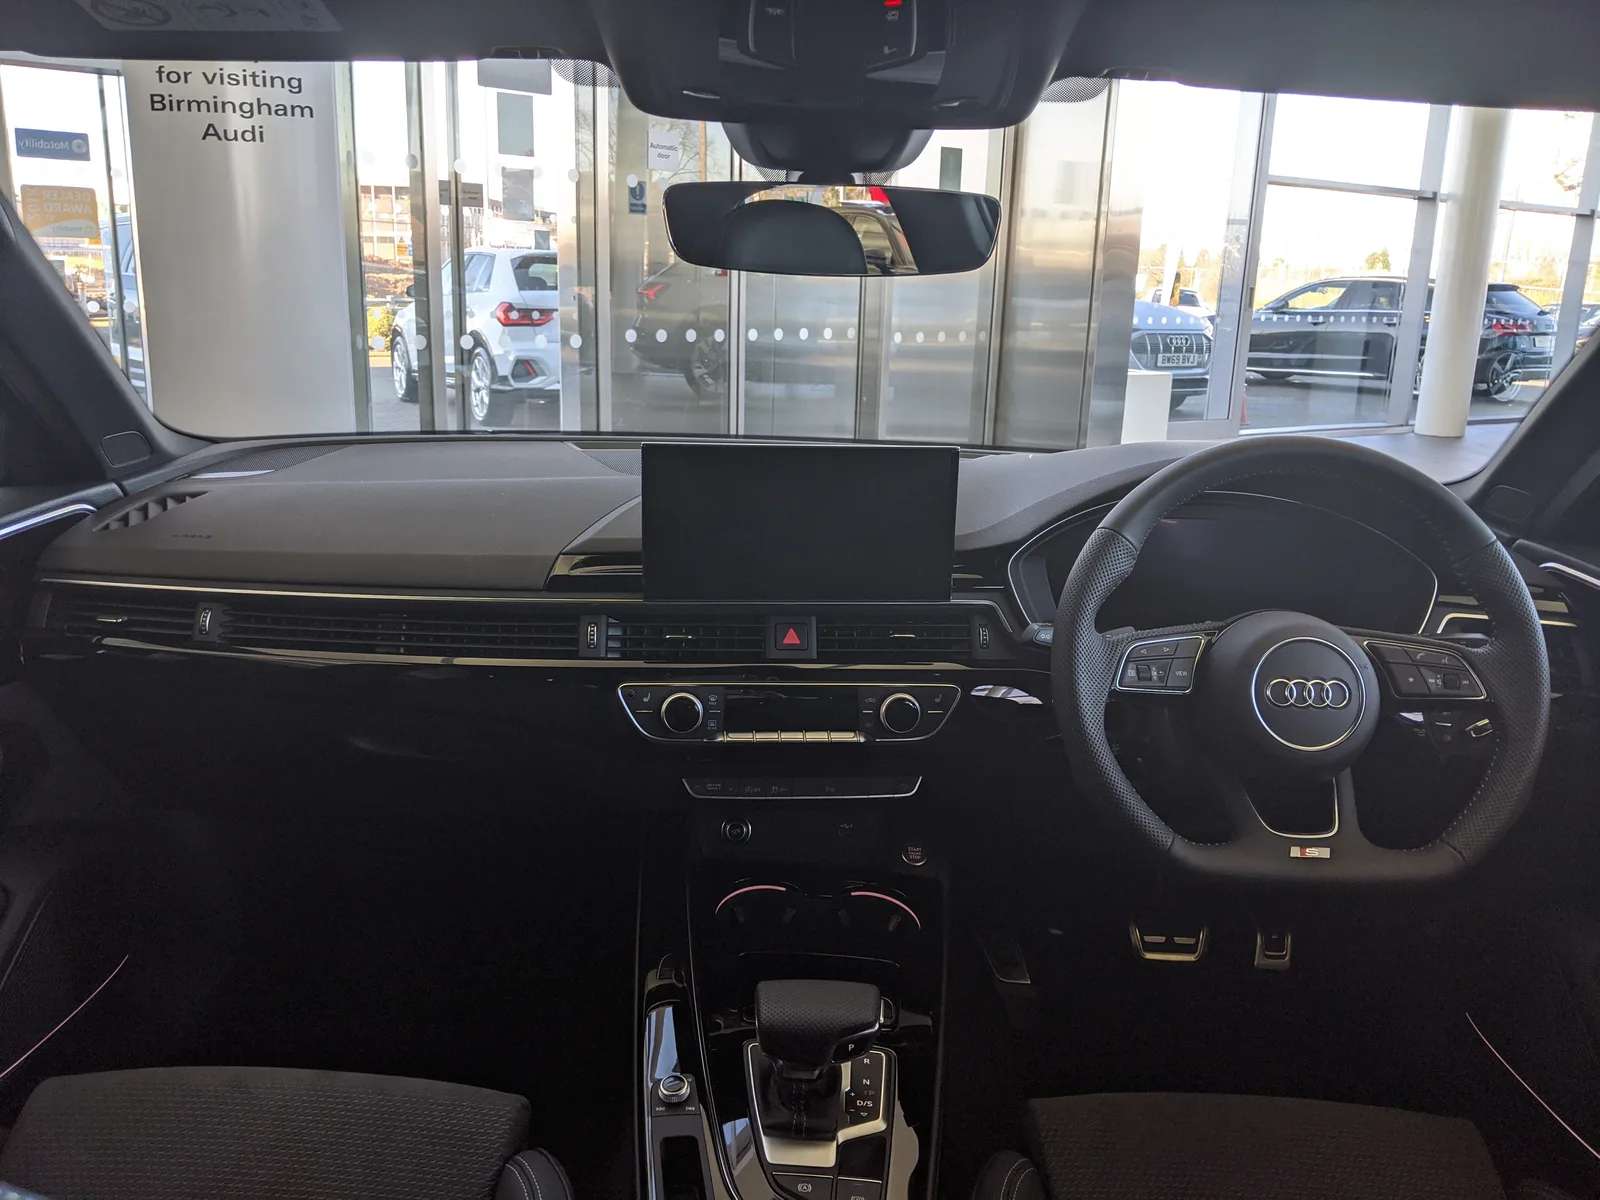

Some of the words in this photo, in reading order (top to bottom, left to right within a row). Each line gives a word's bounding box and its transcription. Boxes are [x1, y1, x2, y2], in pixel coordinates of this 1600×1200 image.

[155, 65, 193, 84] for
[201, 67, 303, 95] visiting
[149, 93, 315, 119] Birmingham
[201, 122, 265, 143] Audi
[649, 142, 679, 152] Automatic
[657, 152, 670, 160] door
[848, 1044, 855, 1052] P
[856, 1099, 873, 1108] D/S
